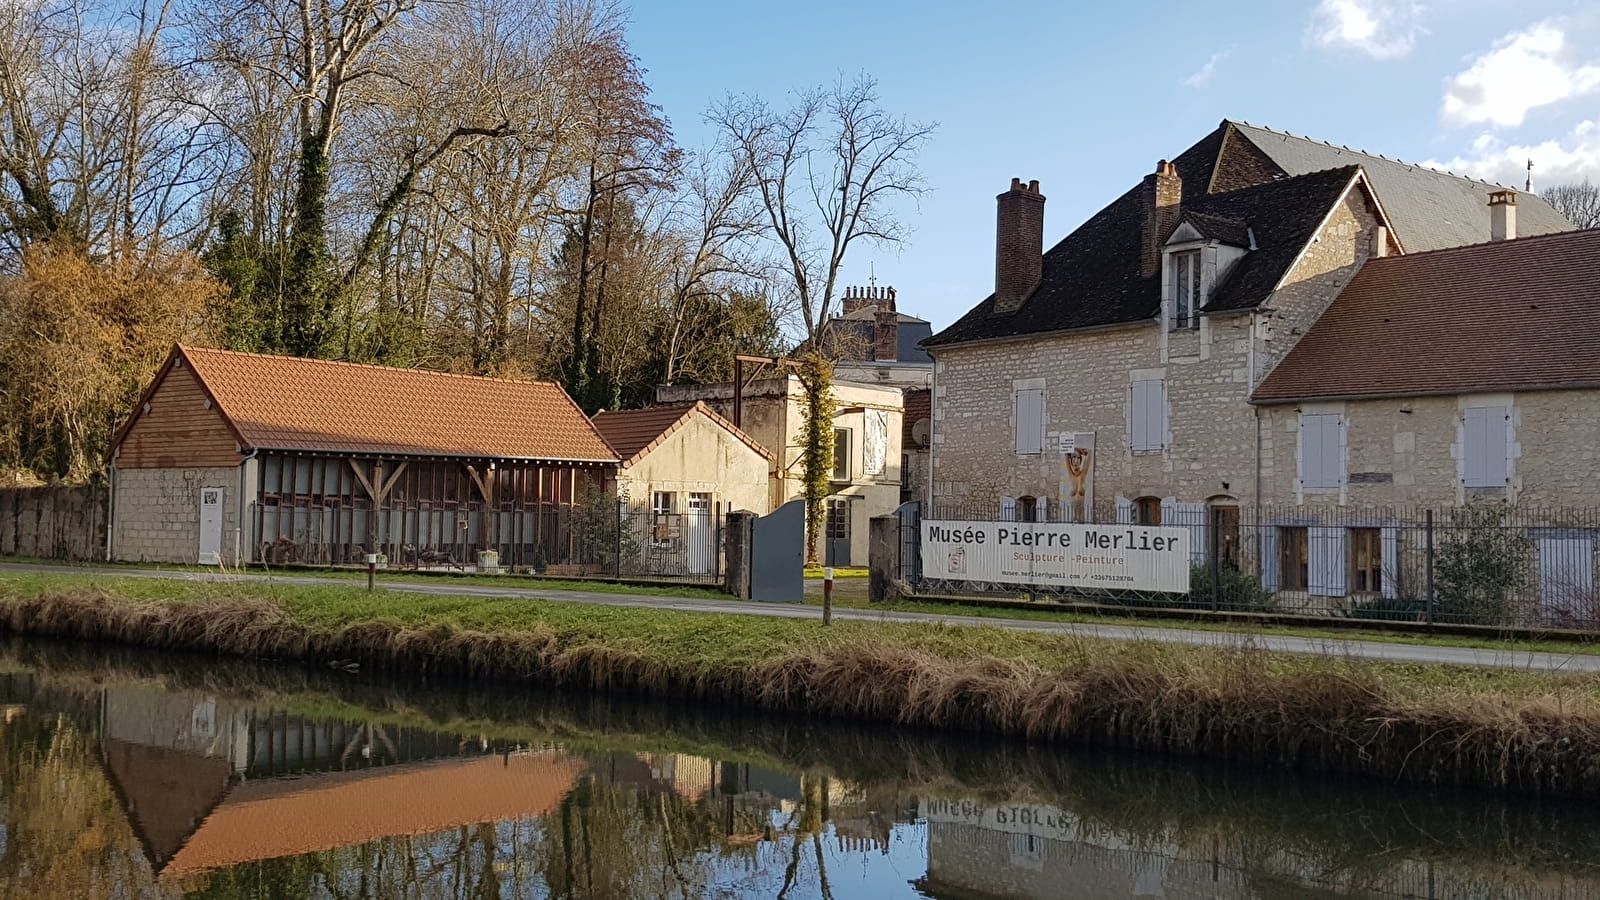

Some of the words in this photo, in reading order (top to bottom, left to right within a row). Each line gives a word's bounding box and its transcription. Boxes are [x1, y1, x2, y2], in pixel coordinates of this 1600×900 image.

[929, 526, 985, 544] Musée
[998, 528, 1071, 548] Pierre
[1085, 531, 1179, 551] Merlier
[1013, 551, 1065, 564] Sculpture
